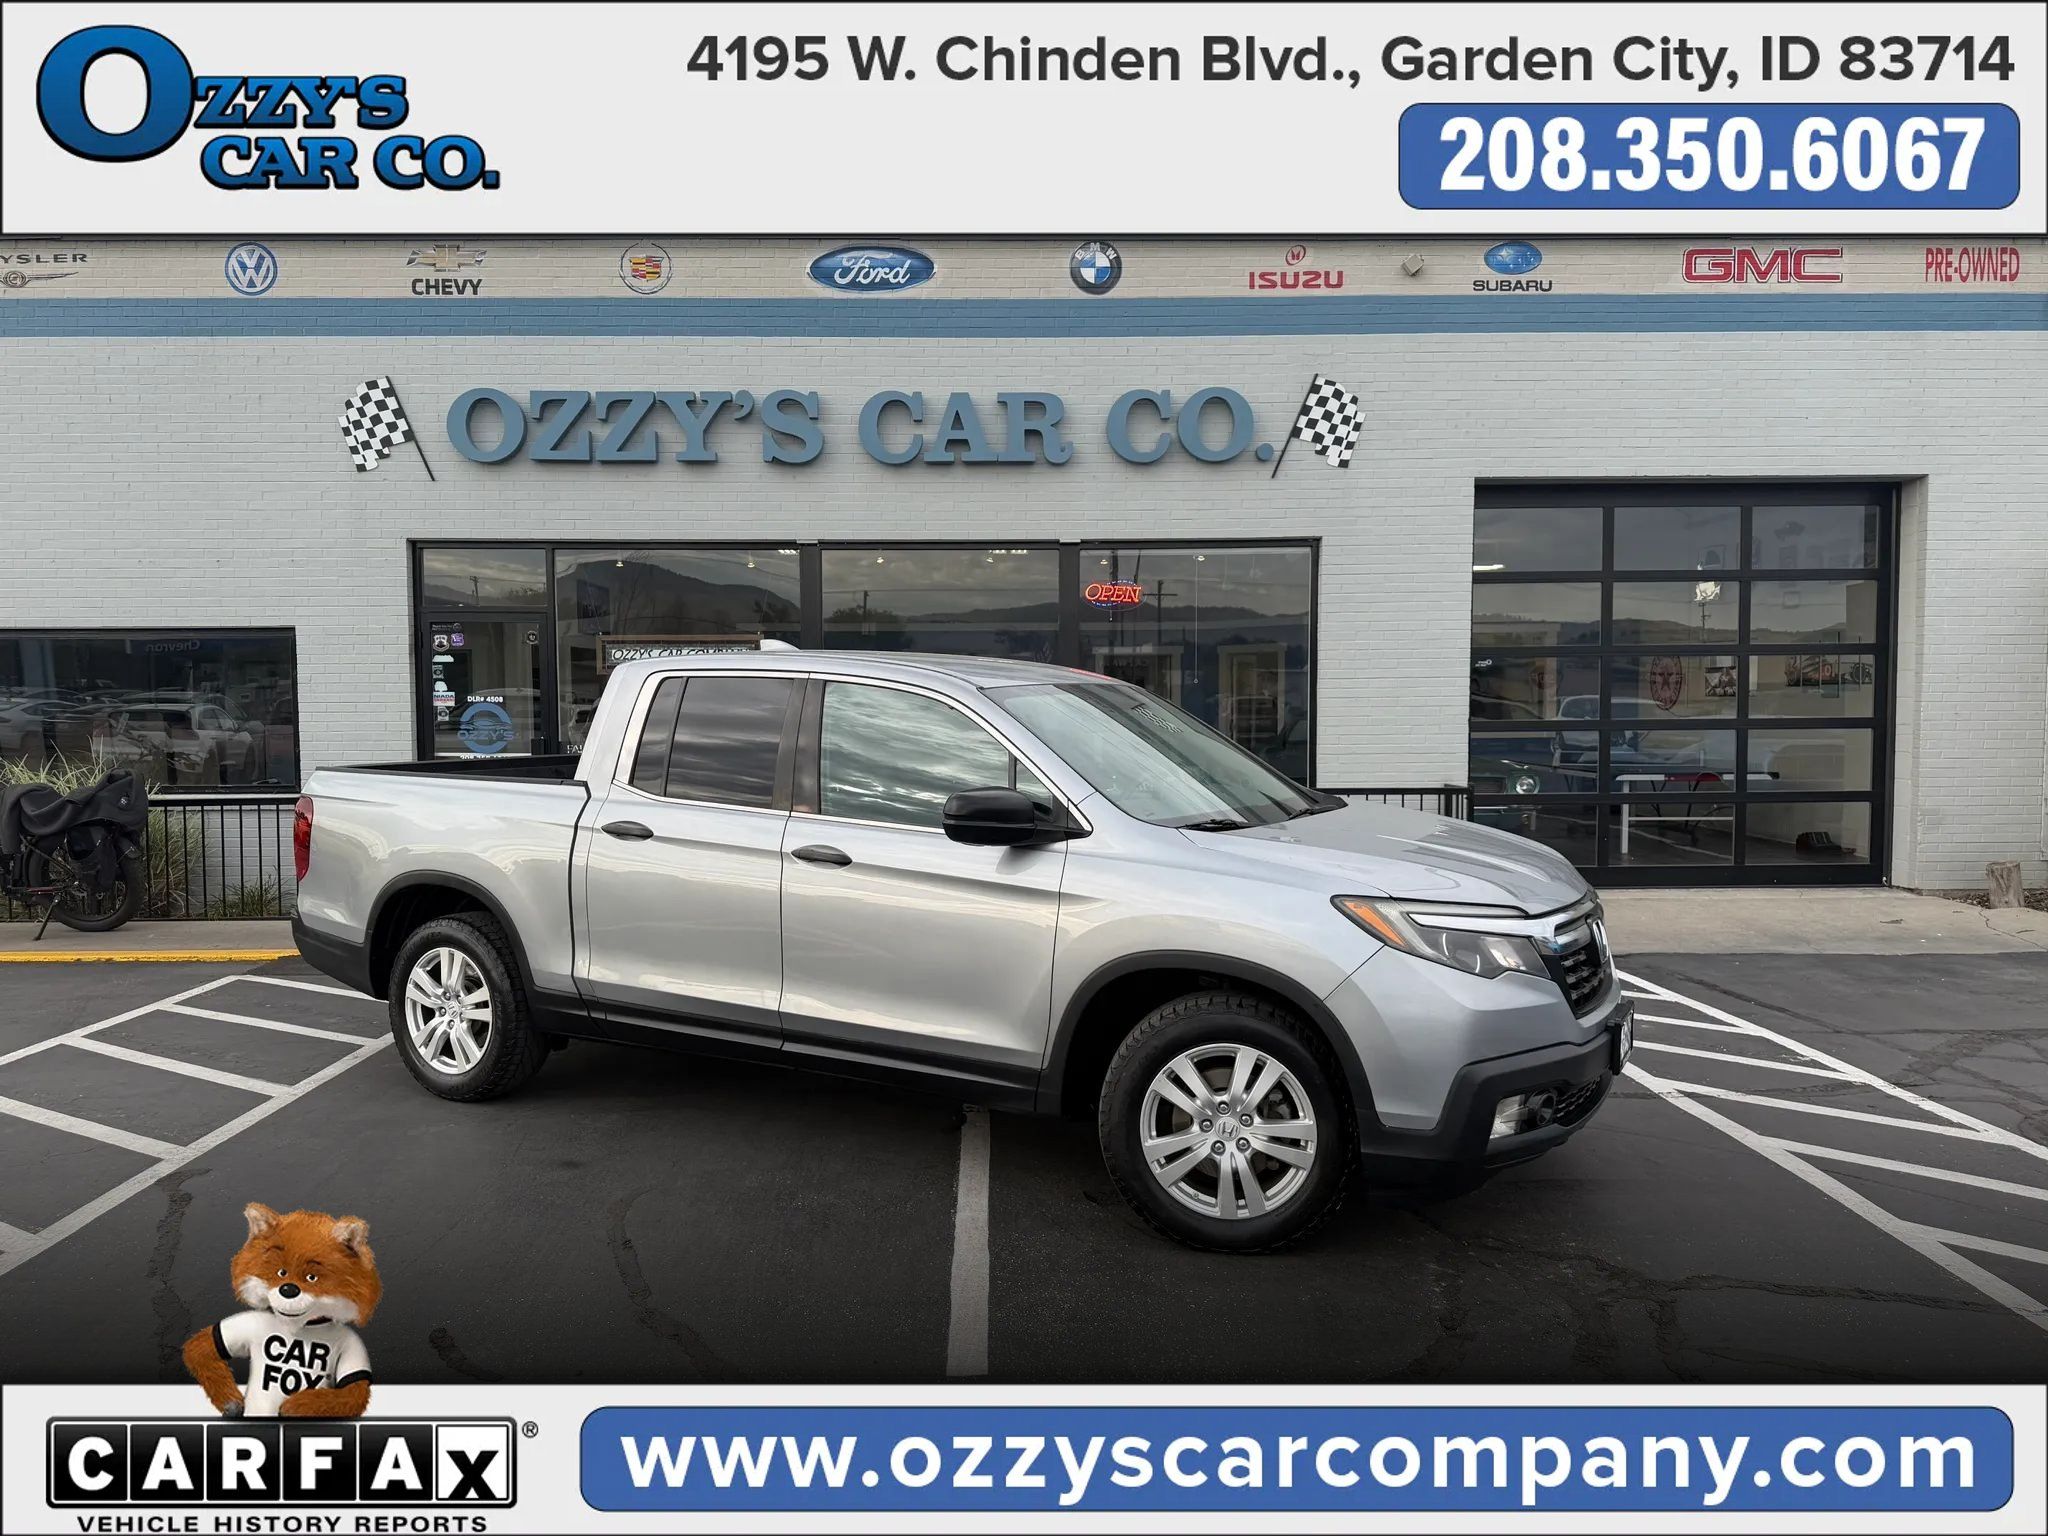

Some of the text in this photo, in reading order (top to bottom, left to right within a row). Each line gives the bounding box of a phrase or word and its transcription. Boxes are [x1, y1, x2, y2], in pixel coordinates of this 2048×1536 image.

[1075, 242, 1118, 260] BMW
[833, 254, 912, 284] Ford
[1682, 247, 1843, 284] GMC
[1925, 247, 2021, 283] PRE-OWNED
[411, 277, 483, 297] CHEVY
[1249, 270, 1344, 290] ISUZU
[1473, 280, 1553, 293] SUBARU
[446, 386, 1275, 466] OZZY'S CAR CO.
[1085, 583, 1142, 602] OPEN
[457, 730, 515, 740] OZZY'S
